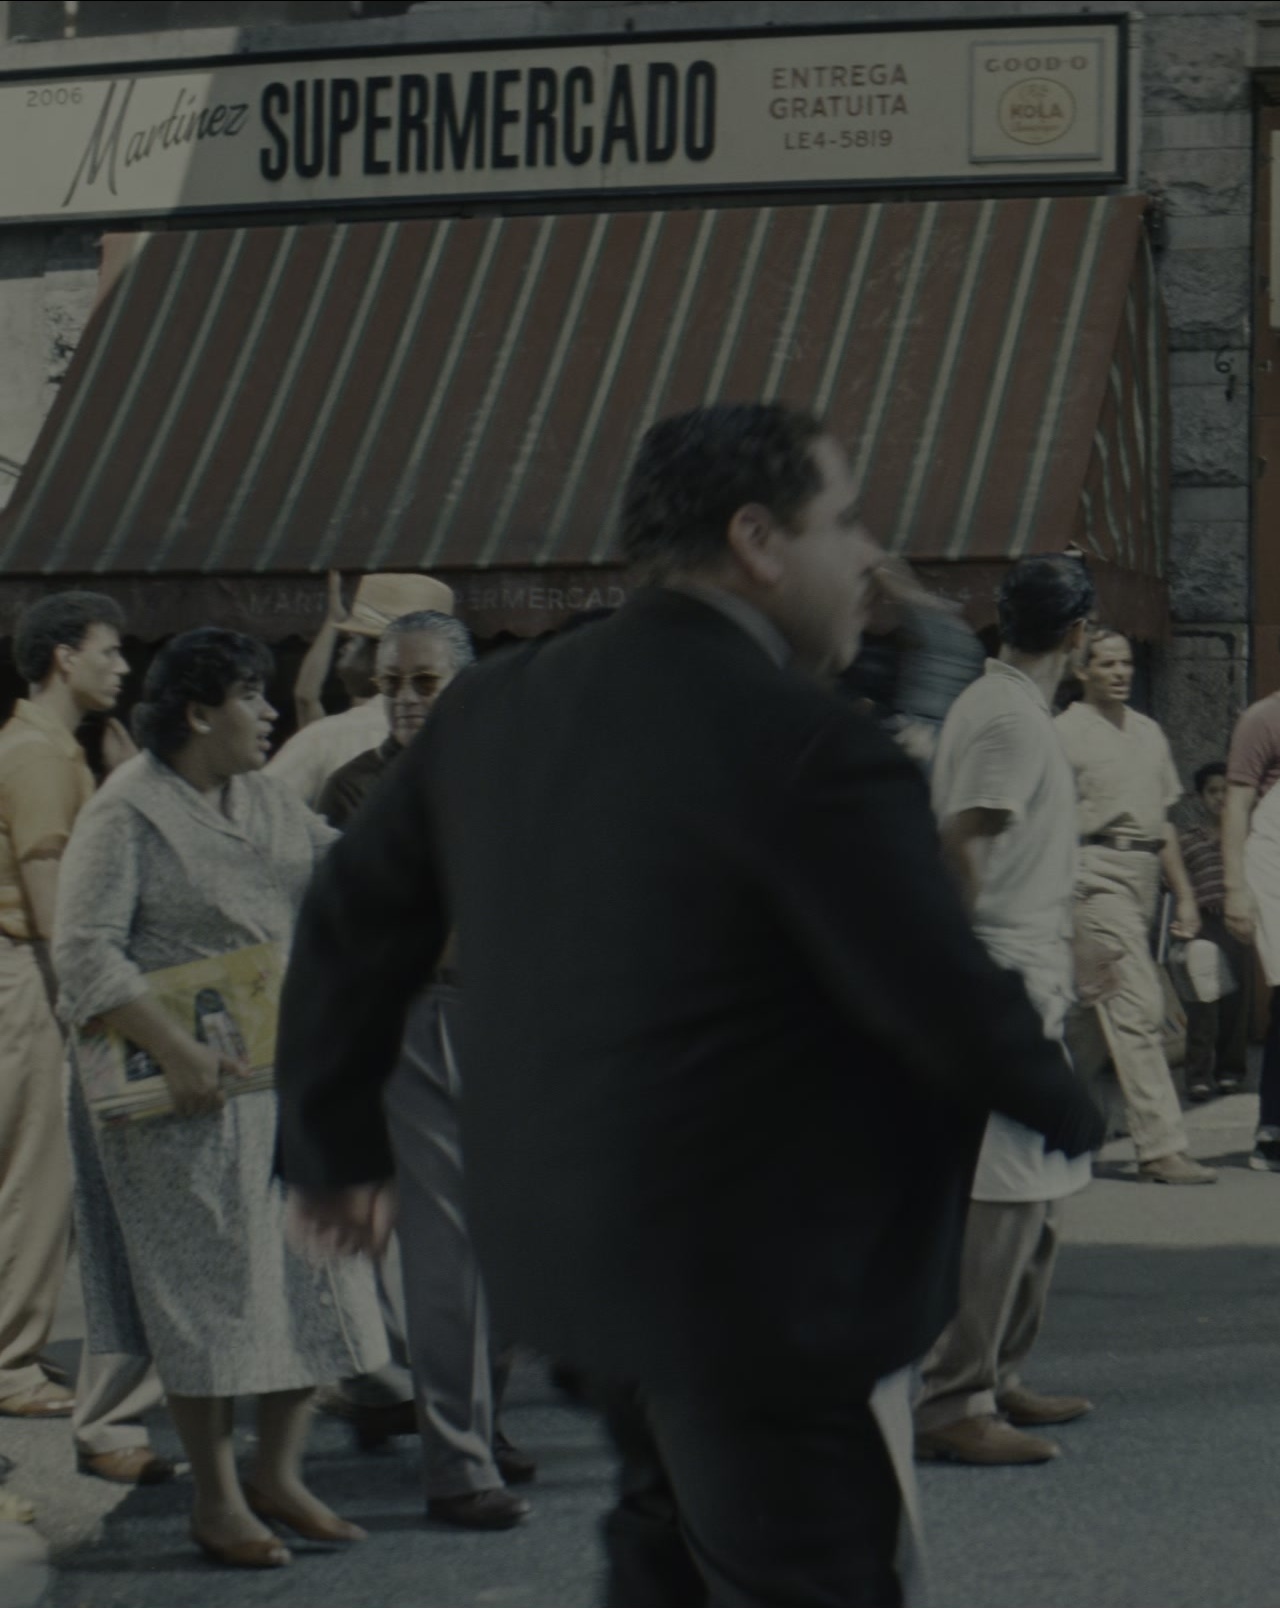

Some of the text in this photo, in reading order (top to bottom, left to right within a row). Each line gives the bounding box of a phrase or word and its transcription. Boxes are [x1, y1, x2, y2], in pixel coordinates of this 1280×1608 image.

[771, 63, 909, 91] ENTREGA
[25, 87, 84, 108] 2006
[768, 93, 909, 120] GRATUITA
[259, 60, 718, 182] SUPERMERCADO
[783, 130, 894, 151] LE4-5819
